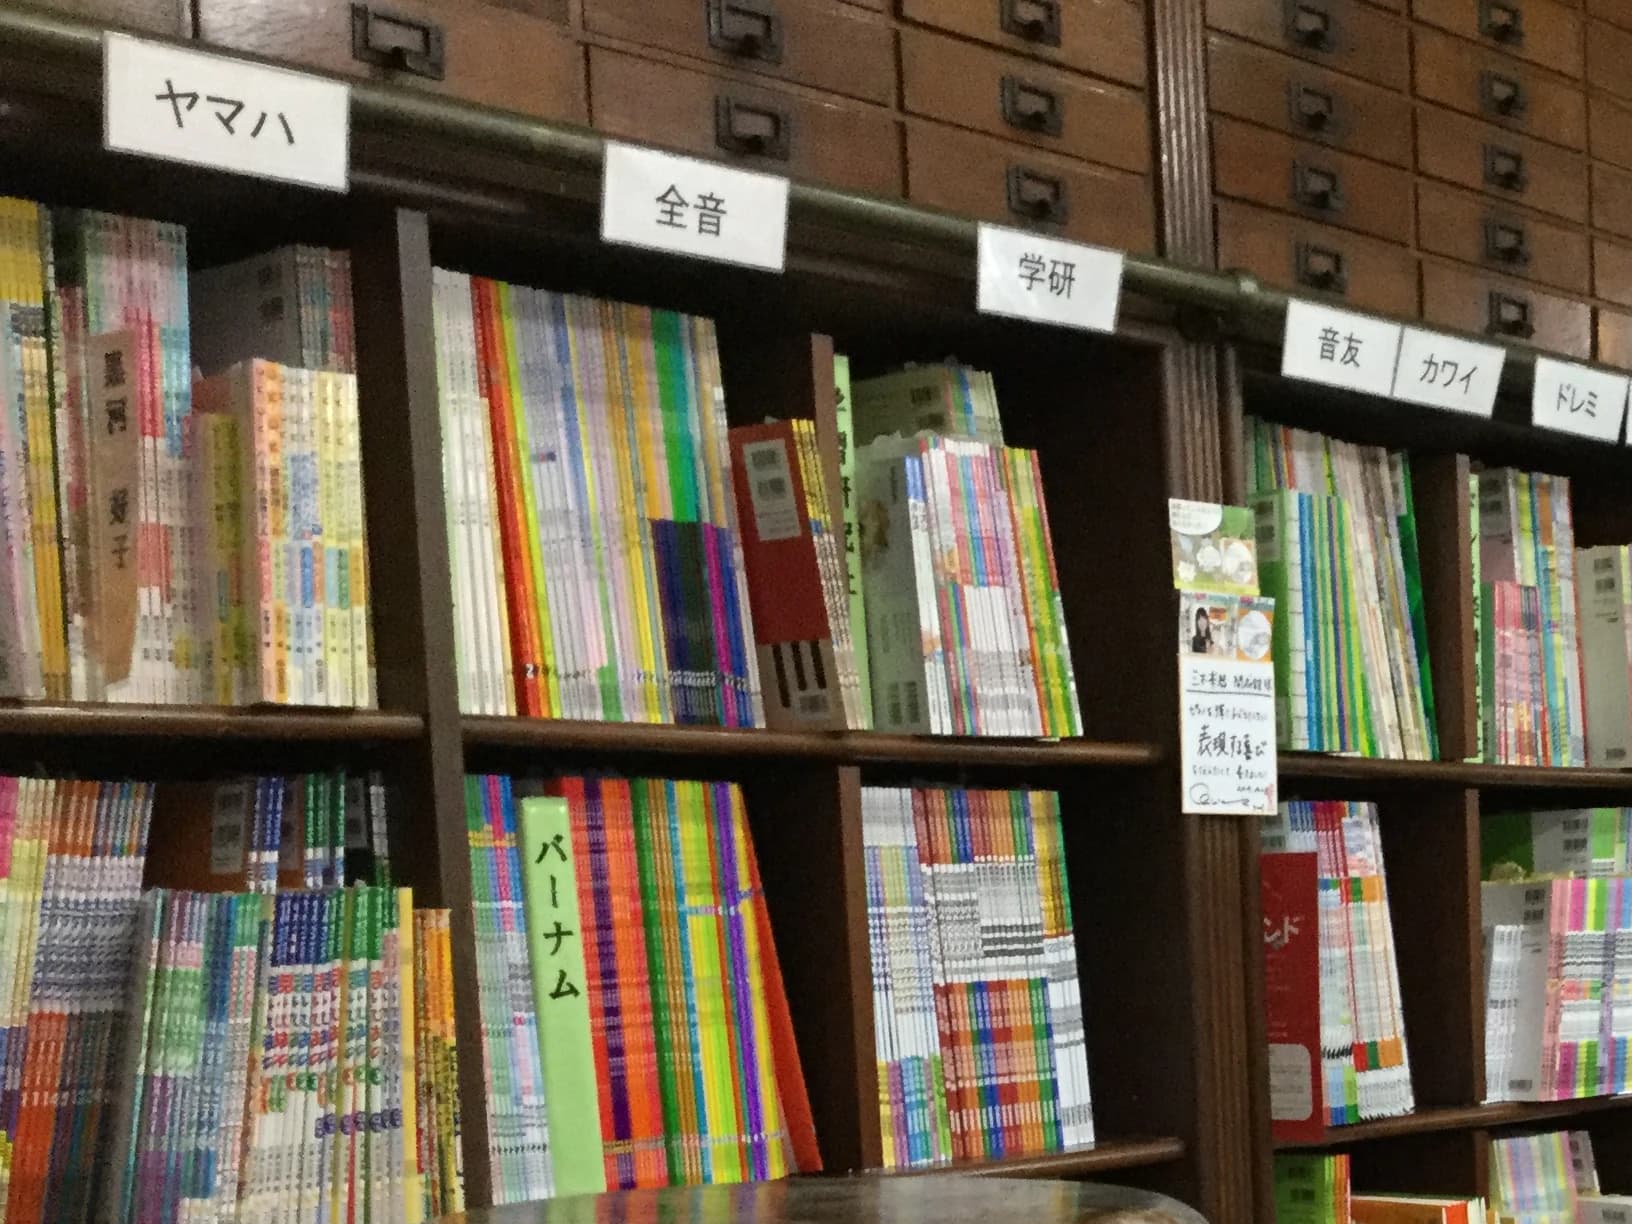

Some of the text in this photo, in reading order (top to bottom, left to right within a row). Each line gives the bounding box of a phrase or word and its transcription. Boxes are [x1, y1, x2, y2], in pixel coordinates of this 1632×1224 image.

[156, 79, 295, 146] ヤマハ
[655, 184, 727, 236] 全音
[1019, 252, 1076, 299] 学研
[1318, 327, 1363, 367] 音友
[1421, 354, 1479, 394] カワイ
[1556, 384, 1598, 418] ドレミ
[535, 834, 581, 1000] バーナム
